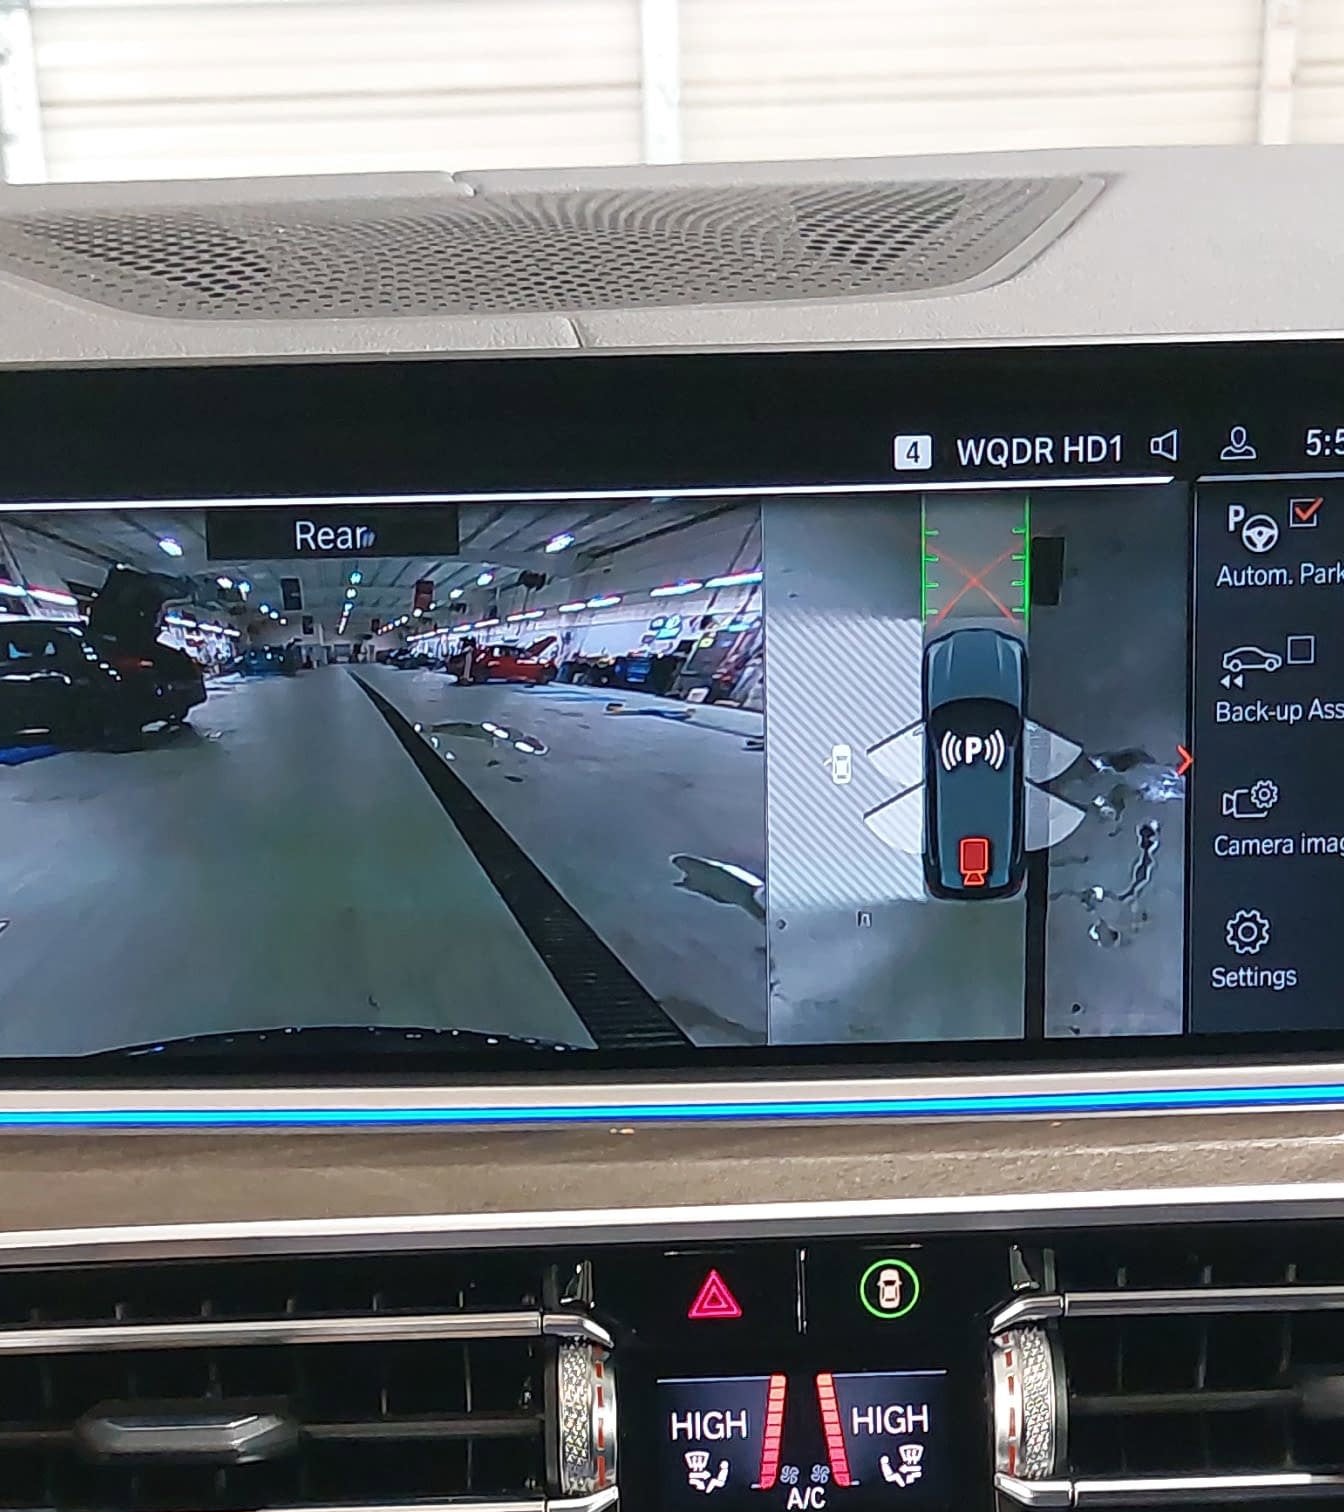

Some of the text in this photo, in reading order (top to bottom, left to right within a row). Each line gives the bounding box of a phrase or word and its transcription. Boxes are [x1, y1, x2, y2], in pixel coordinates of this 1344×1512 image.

[904, 435, 1123, 466] 4 WQDR HD1
[295, 520, 368, 550] Rear
[1216, 564, 1293, 588] Autom.
[1216, 699, 1302, 724] Back-up
[1214, 834, 1294, 856] Camera
[1211, 966, 1297, 990] Settings
[670, 1409, 748, 1440] HIGH
[851, 1404, 930, 1436] HIGH
[786, 1486, 826, 1511] A/C
